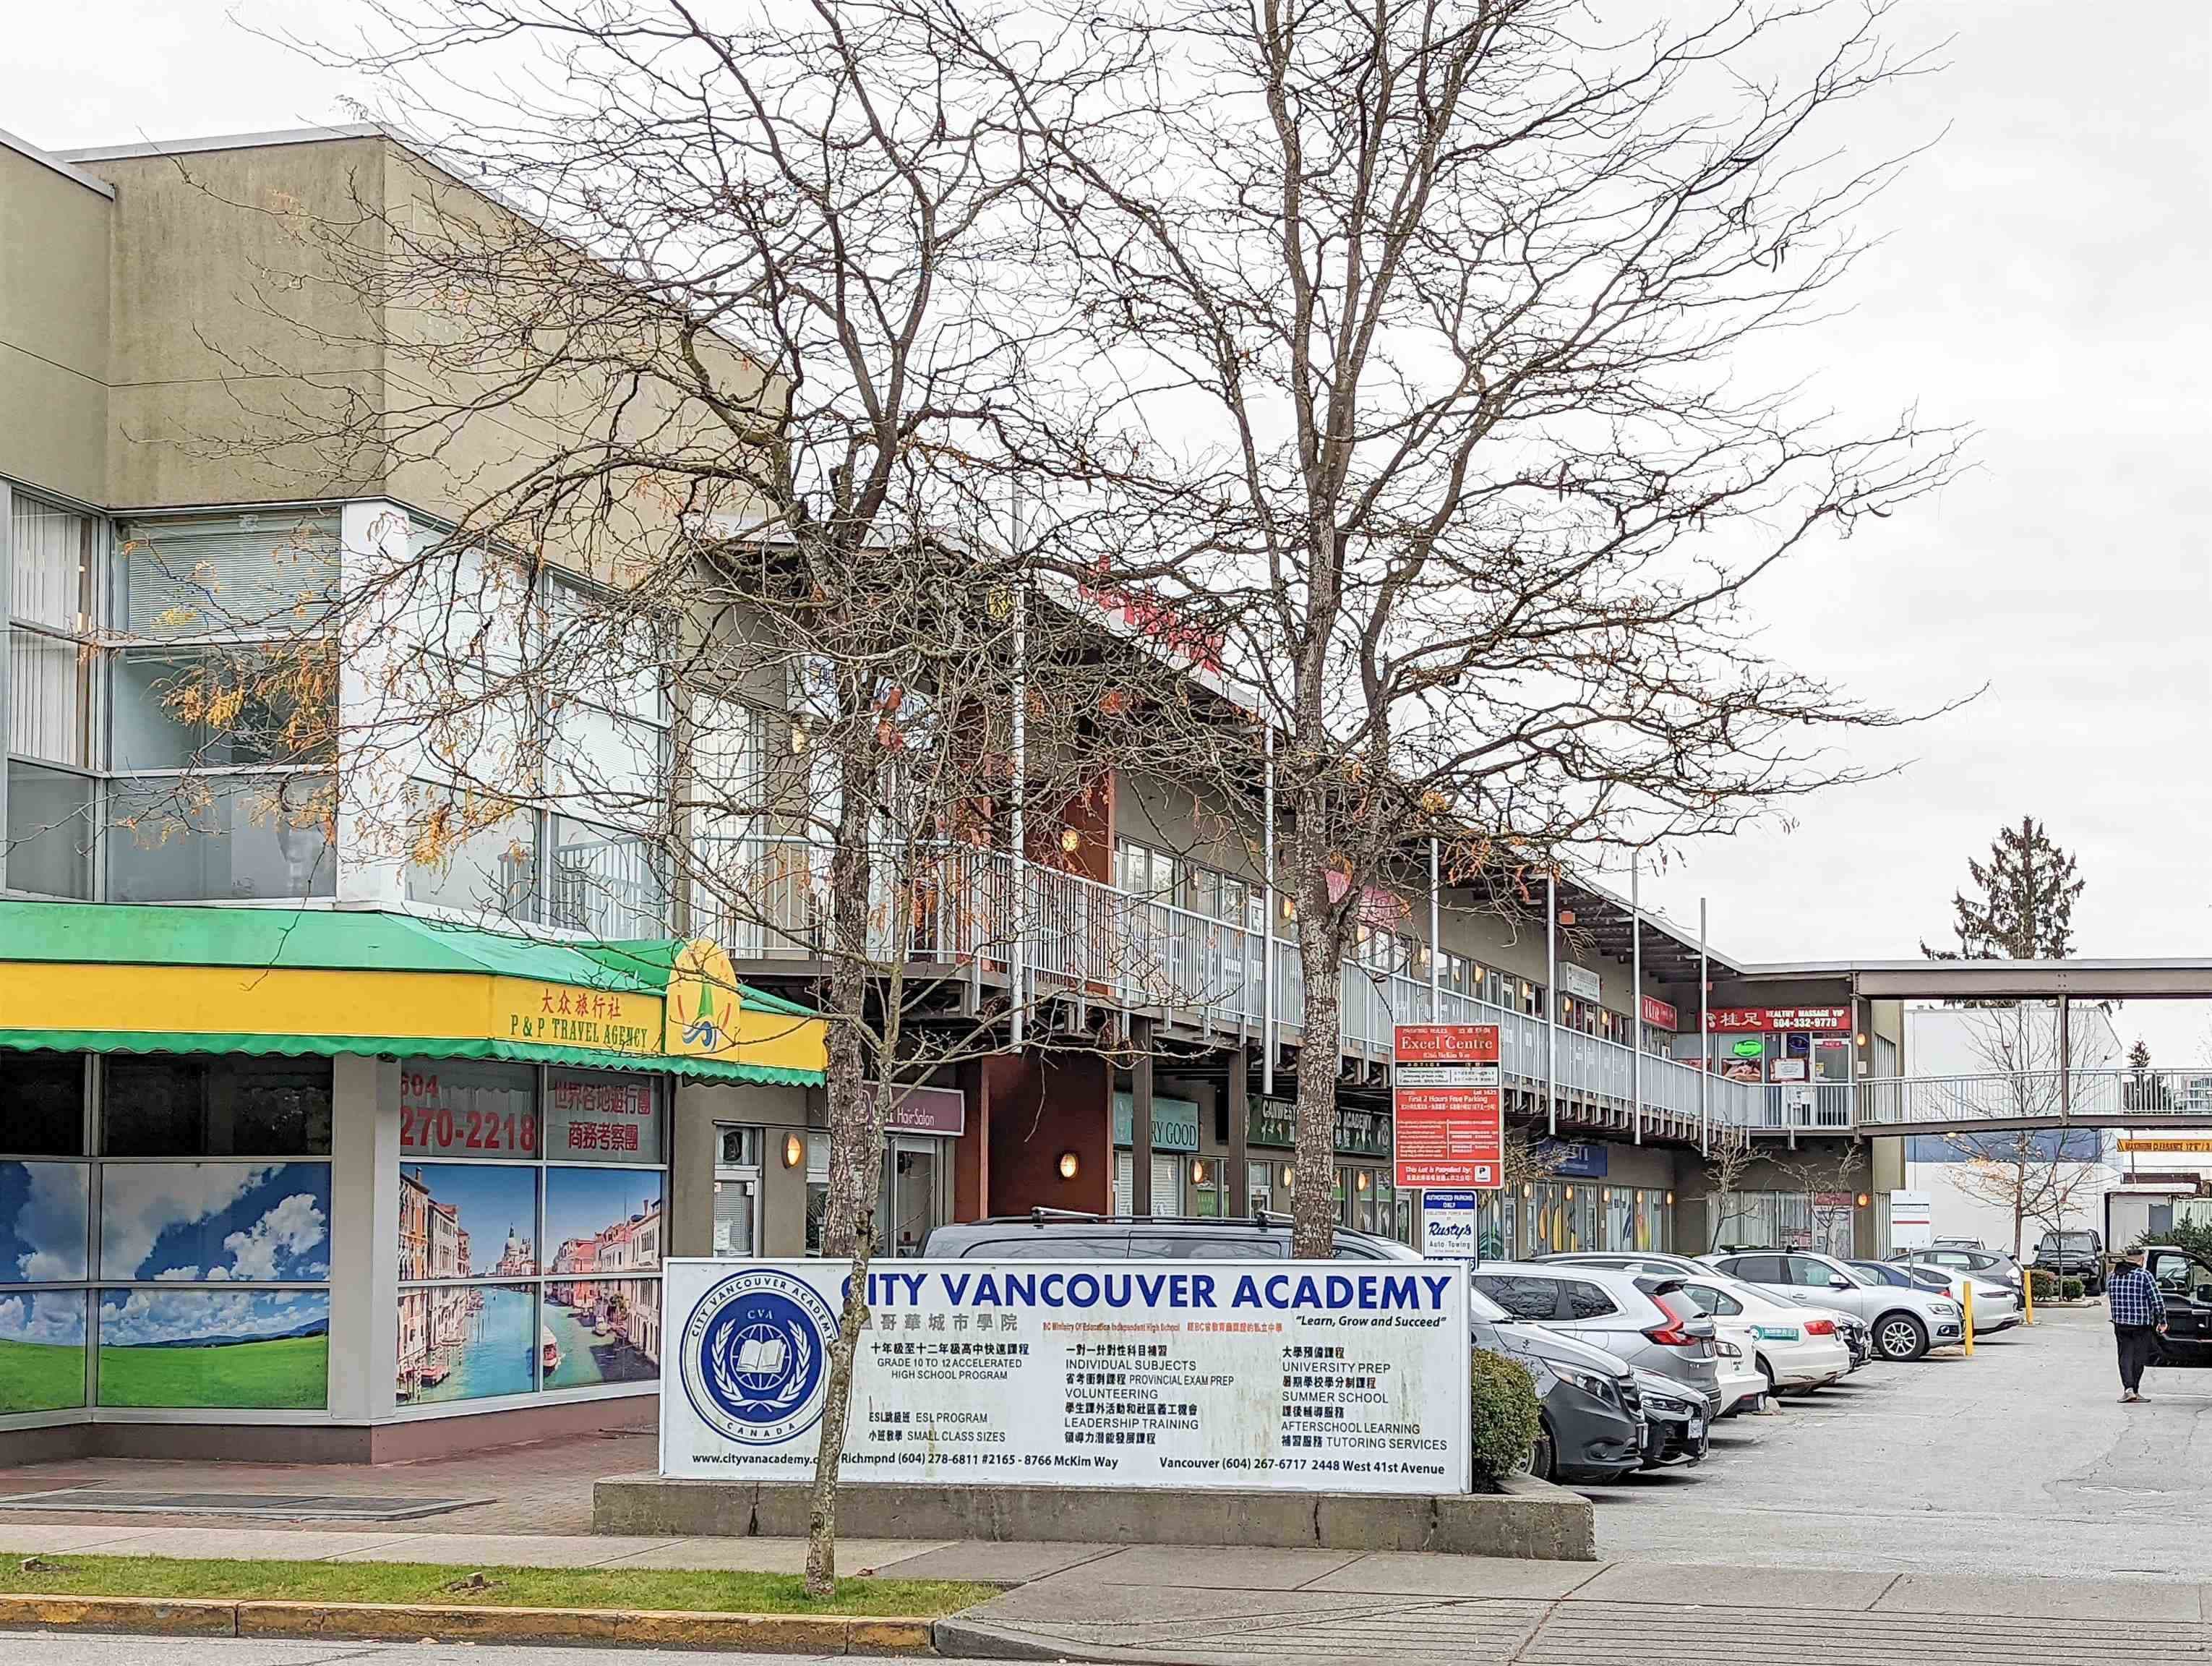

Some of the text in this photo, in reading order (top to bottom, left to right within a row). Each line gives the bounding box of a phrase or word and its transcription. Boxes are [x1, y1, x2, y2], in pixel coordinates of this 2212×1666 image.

[542, 988, 621, 1020] 大众旅行社
[510, 1014, 648, 1048] P & P TRAVEL AGENCY
[1402, 1035, 1493, 1049] Excel Centre
[897, 1107, 914, 1124] Hair
[914, 1108, 935, 1126] Salon
[400, 1106, 536, 1151] 270-2218
[1166, 1122, 1196, 1146] GOOD
[569, 1121, 638, 1151] 商務考察團
[1428, 1222, 1472, 1239] Rusty's
[1448, 1240, 1470, 1250] Towing
[940, 1273, 1217, 1308] VANCOUVER
[1231, 1275, 1452, 1310] ACADEMY
[691, 1278, 833, 1340] CITY VANCOUVER ACADEMY
[747, 1310, 774, 1320] CVA
[862, 1313, 1018, 1331] 哥華城市學院
[1339, 1316, 1368, 1327] Grow
[1371, 1317, 1392, 1327] and
[878, 1359, 1022, 1368] GRADE 10 TO 12 ACCELERATED
[1066, 1359, 1196, 1371] INDIVIDUAL SUBJECTS
[1282, 1362, 1391, 1374] UNIVERSITY PREP
[892, 1370, 1008, 1380] HIGH SCHOOL PROGRAM
[1129, 1375, 1235, 1386] PROVINCIAL EXAM PREP
[1066, 1388, 1158, 1399] VOLUNTEERING
[1282, 1391, 1389, 1404] SUMMER SCHOOL
[916, 1412, 987, 1423] ESL PROGRAM
[1064, 1417, 1199, 1430] LEADERSHIP TRAINING
[726, 1422, 795, 1438] CANADA
[1282, 1422, 1420, 1435] AFTERSCHOOL LEARNING
[907, 1431, 1006, 1442] SMALL CLASS SIZES
[1326, 1437, 1447, 1451] TUTORING SERVICES
[693, 1453, 819, 1466] www.cityvanacademy.c
[899, 1453, 925, 1466] (604)
[928, 1453, 977, 1464] 278-6811
[982, 1454, 1015, 1465] #2165
[1024, 1456, 1052, 1466] 8766
[1054, 1456, 1091, 1466] McKim
[1094, 1456, 1119, 1469] Way
[1159, 1457, 1445, 1474] Vancouver (604) 267-6717 2448 West 41st Avenue
